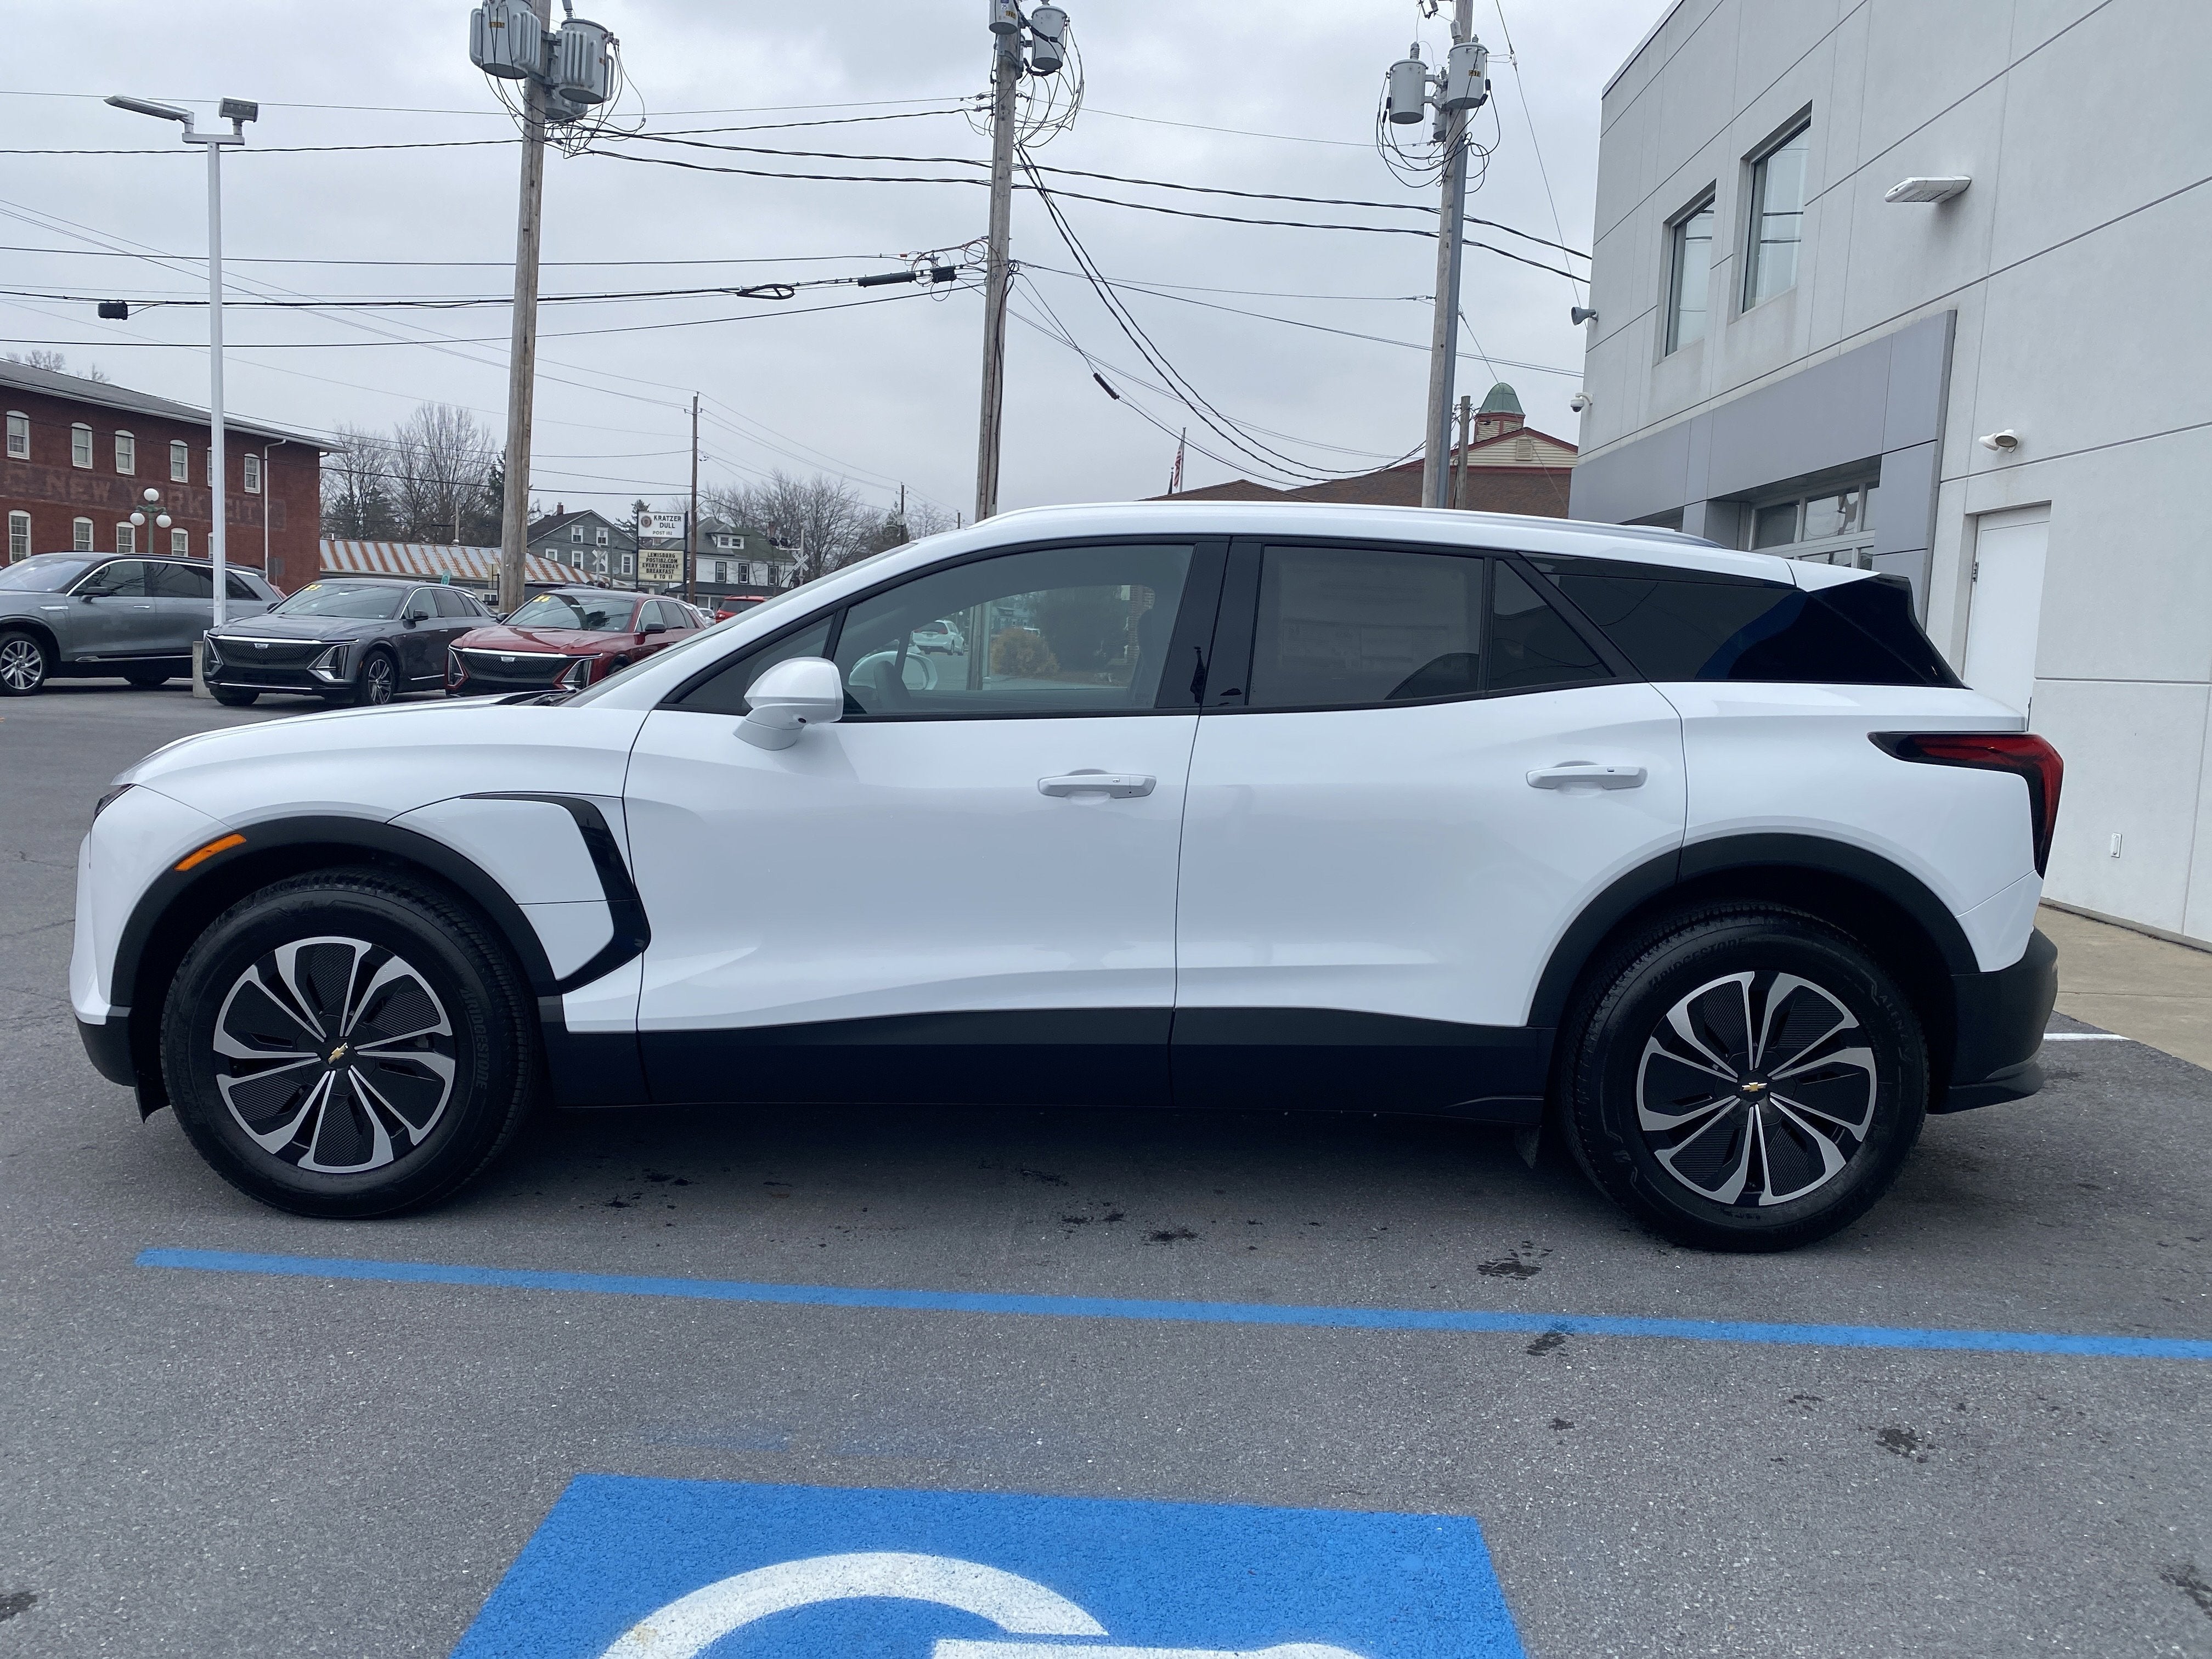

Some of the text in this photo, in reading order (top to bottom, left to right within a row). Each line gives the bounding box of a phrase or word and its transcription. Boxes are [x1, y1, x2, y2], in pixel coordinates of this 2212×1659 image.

[46, 475, 110, 502] NEW
[129, 485, 204, 515] YRK
[1649, 936, 1747, 988] BRIDGESTONE
[459, 988, 490, 1090] BRIDGESTONE
